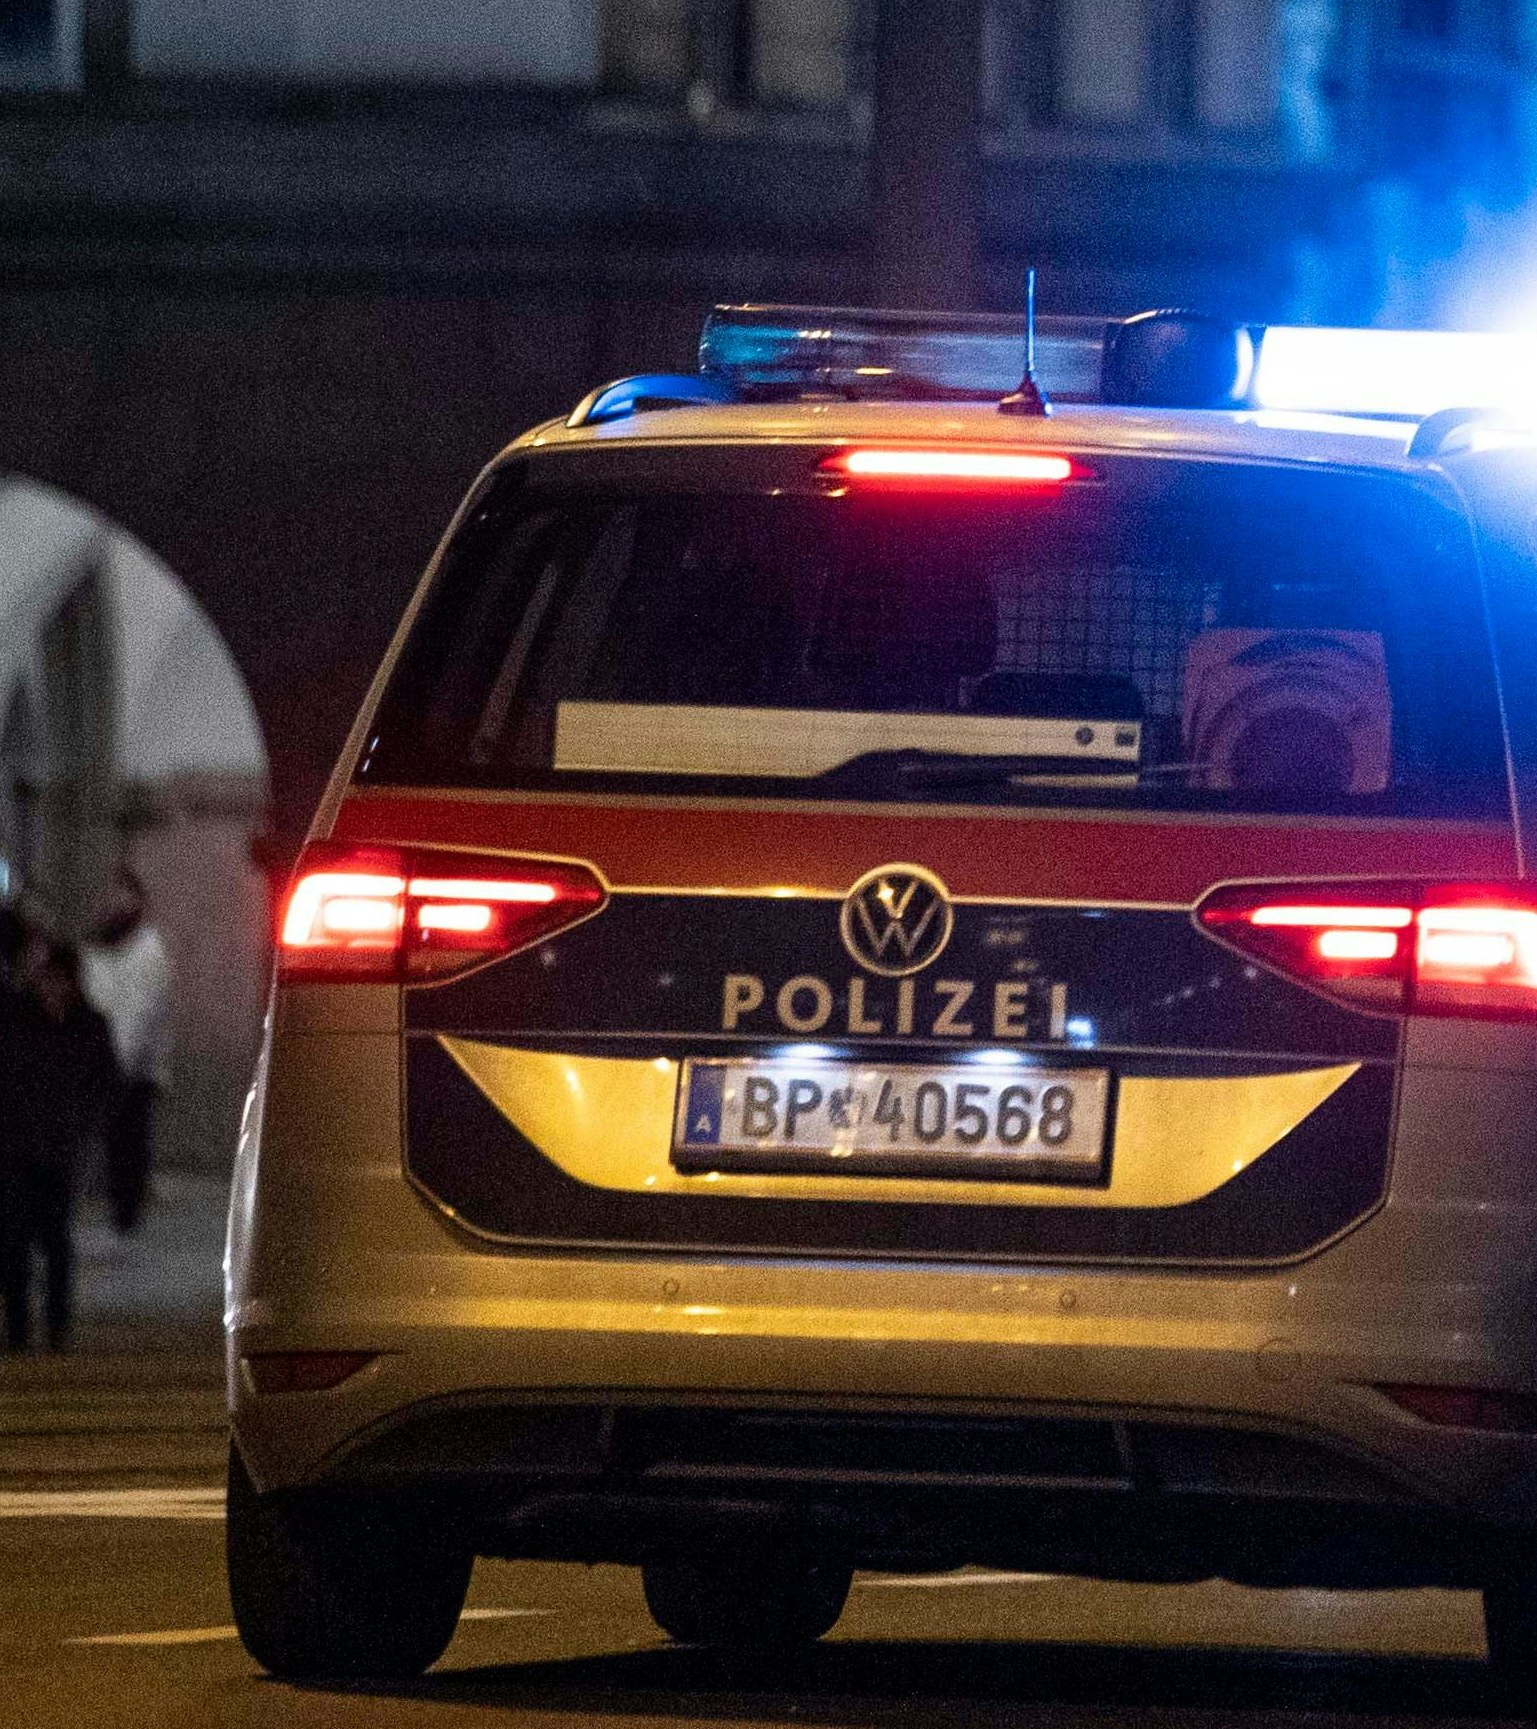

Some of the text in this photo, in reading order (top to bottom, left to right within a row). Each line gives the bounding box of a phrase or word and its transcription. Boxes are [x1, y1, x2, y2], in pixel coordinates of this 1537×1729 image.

[854, 874, 944, 962] VW
[722, 974, 1068, 1041] POLIZEI
[694, 1113, 712, 1133] A
[742, 1076, 1075, 1147] BP 40568
